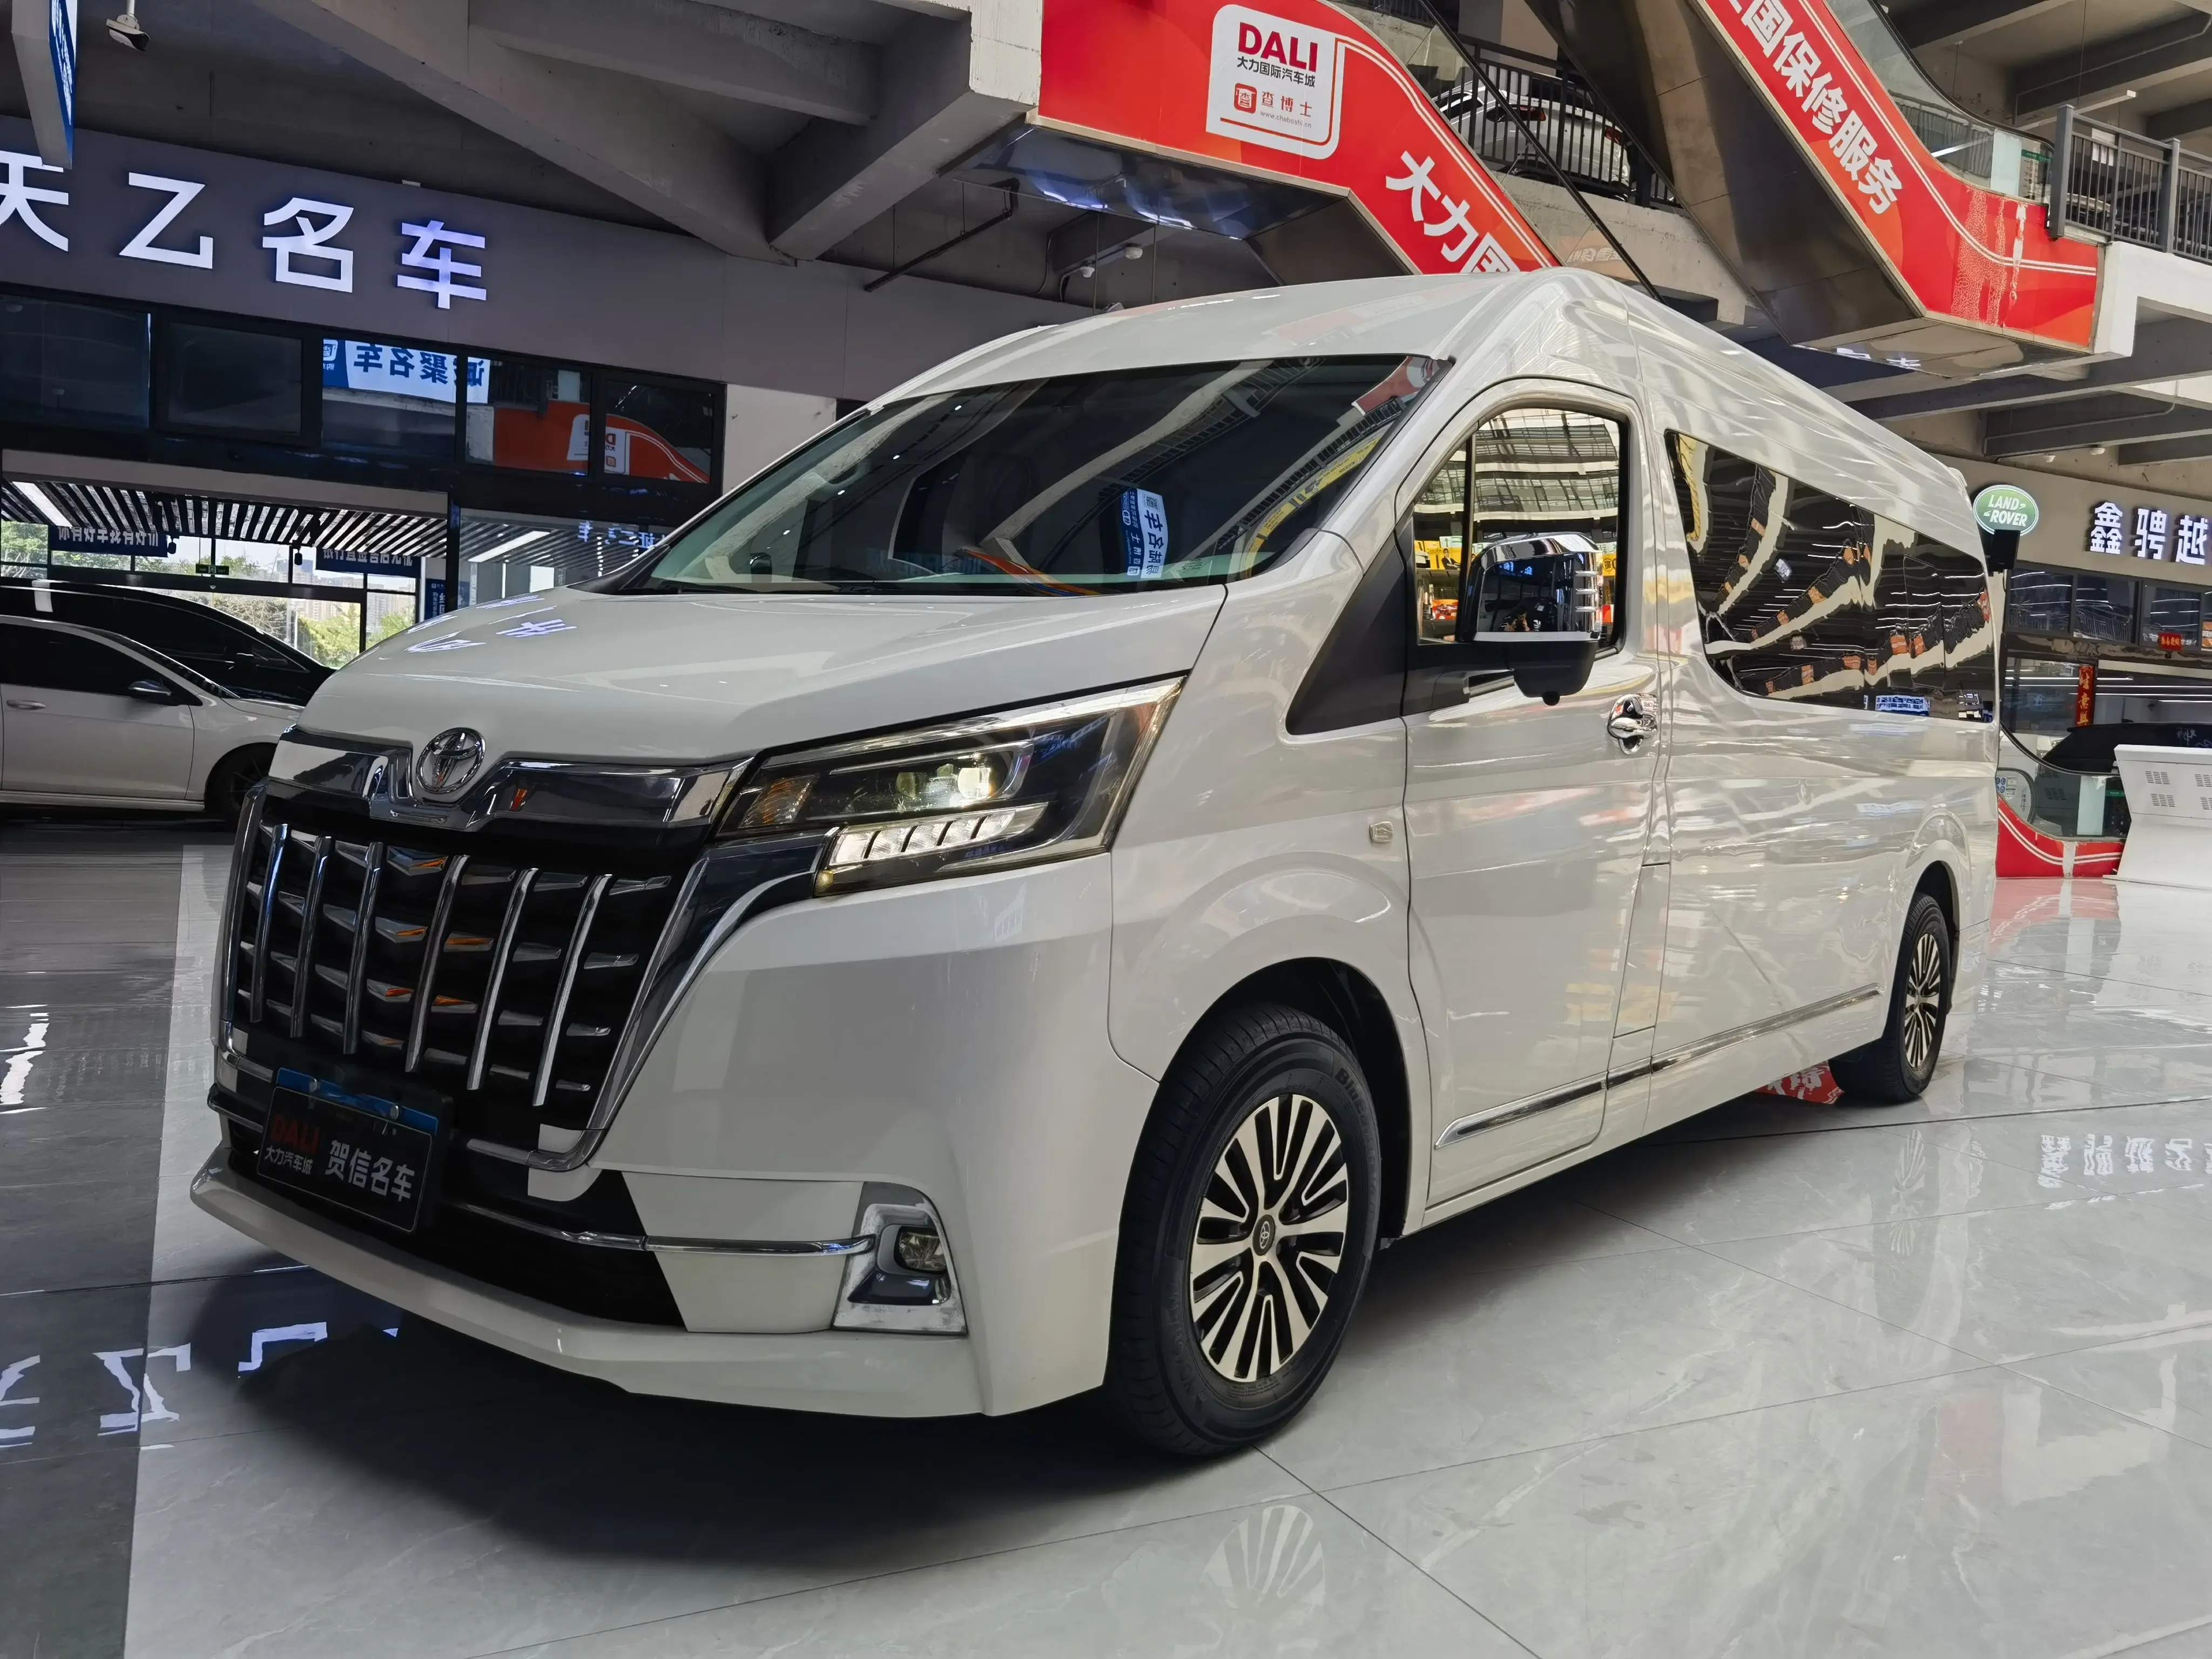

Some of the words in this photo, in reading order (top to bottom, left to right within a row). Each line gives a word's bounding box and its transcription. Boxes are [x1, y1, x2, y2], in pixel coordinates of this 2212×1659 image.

[1238, 22, 1318, 72] DALI
[1237, 56, 1316, 87] 大力国际汽车城
[1260, 110, 1312, 129] www.chaboshi.cn
[1261, 91, 1312, 117] 查博士
[1730, 0, 1903, 214] 国保修服务
[0, 150, 487, 309] 天乙名车
[1988, 495, 2019, 510] LAND
[1990, 511, 2028, 527] ROVER
[2090, 502, 2209, 565] 鑫聘越
[272, 1114, 321, 1154] DALI
[264, 1145, 314, 1176] 大力汽车城
[325, 1139, 415, 1202] 贺信名车
